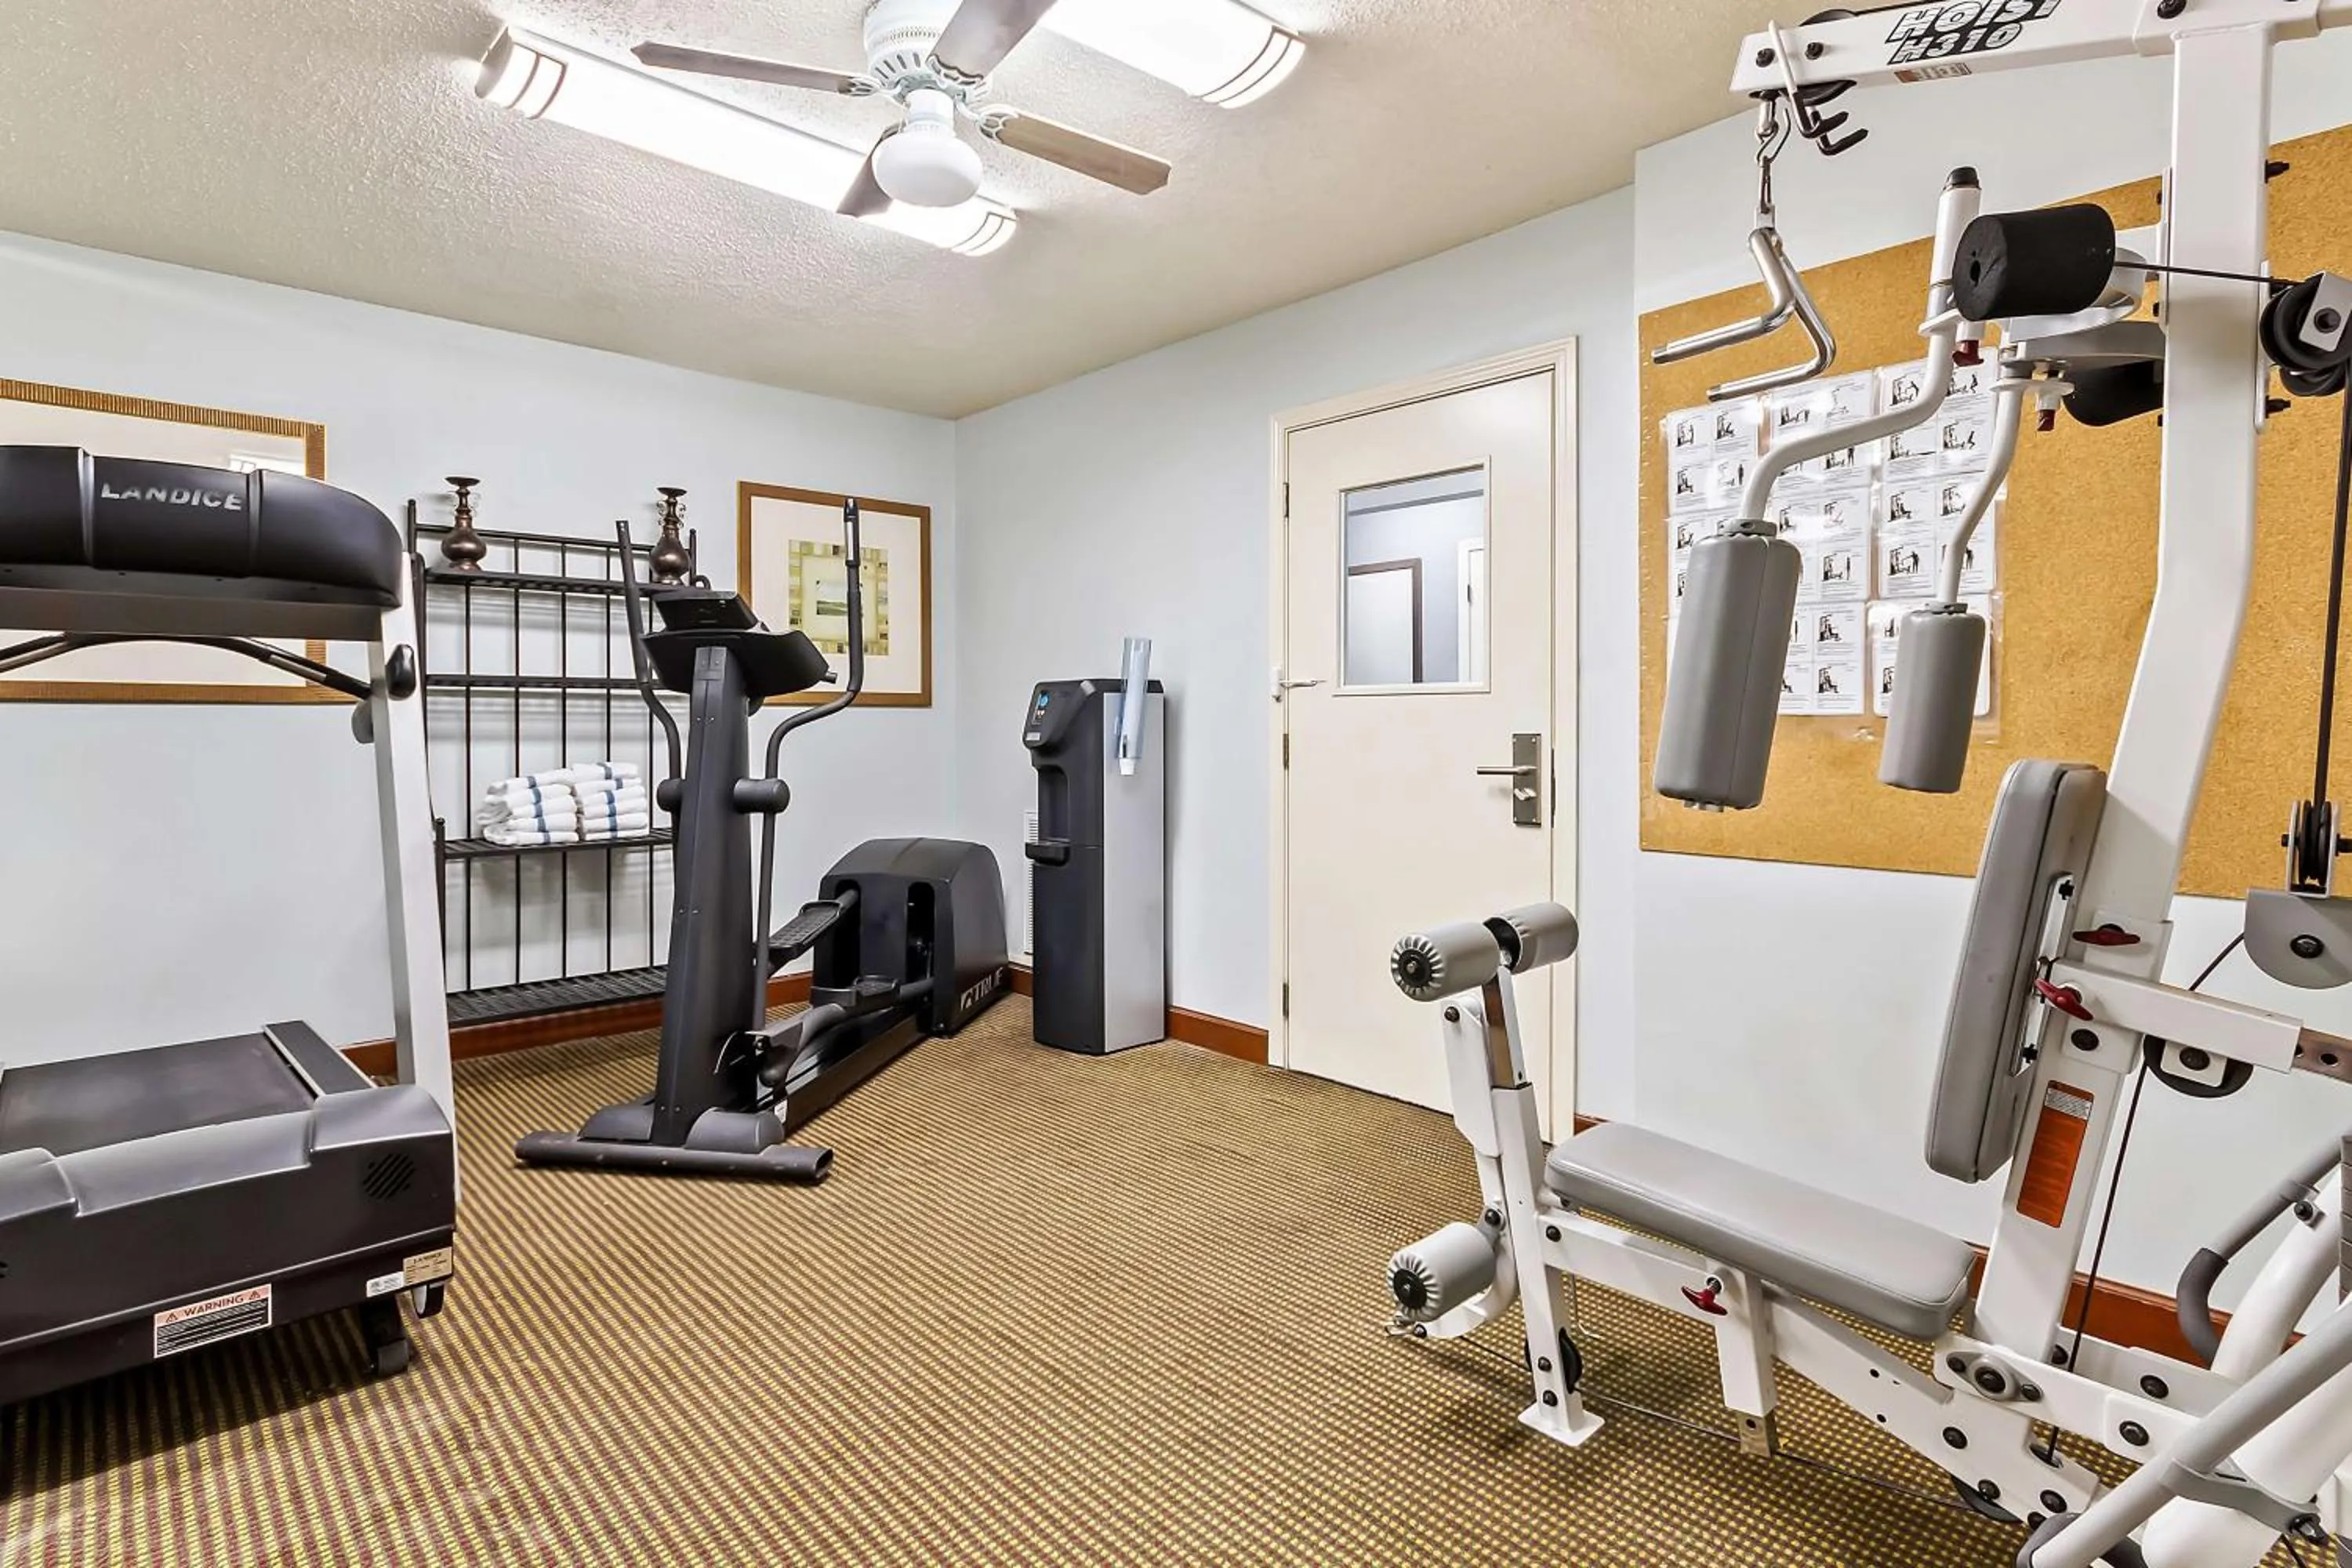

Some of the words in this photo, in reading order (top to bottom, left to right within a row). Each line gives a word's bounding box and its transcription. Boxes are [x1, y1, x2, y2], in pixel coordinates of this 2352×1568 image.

[1887, 23, 2023, 65] H310
[101, 482, 241, 510] LANDICE
[184, 1294, 244, 1316] WARNING
